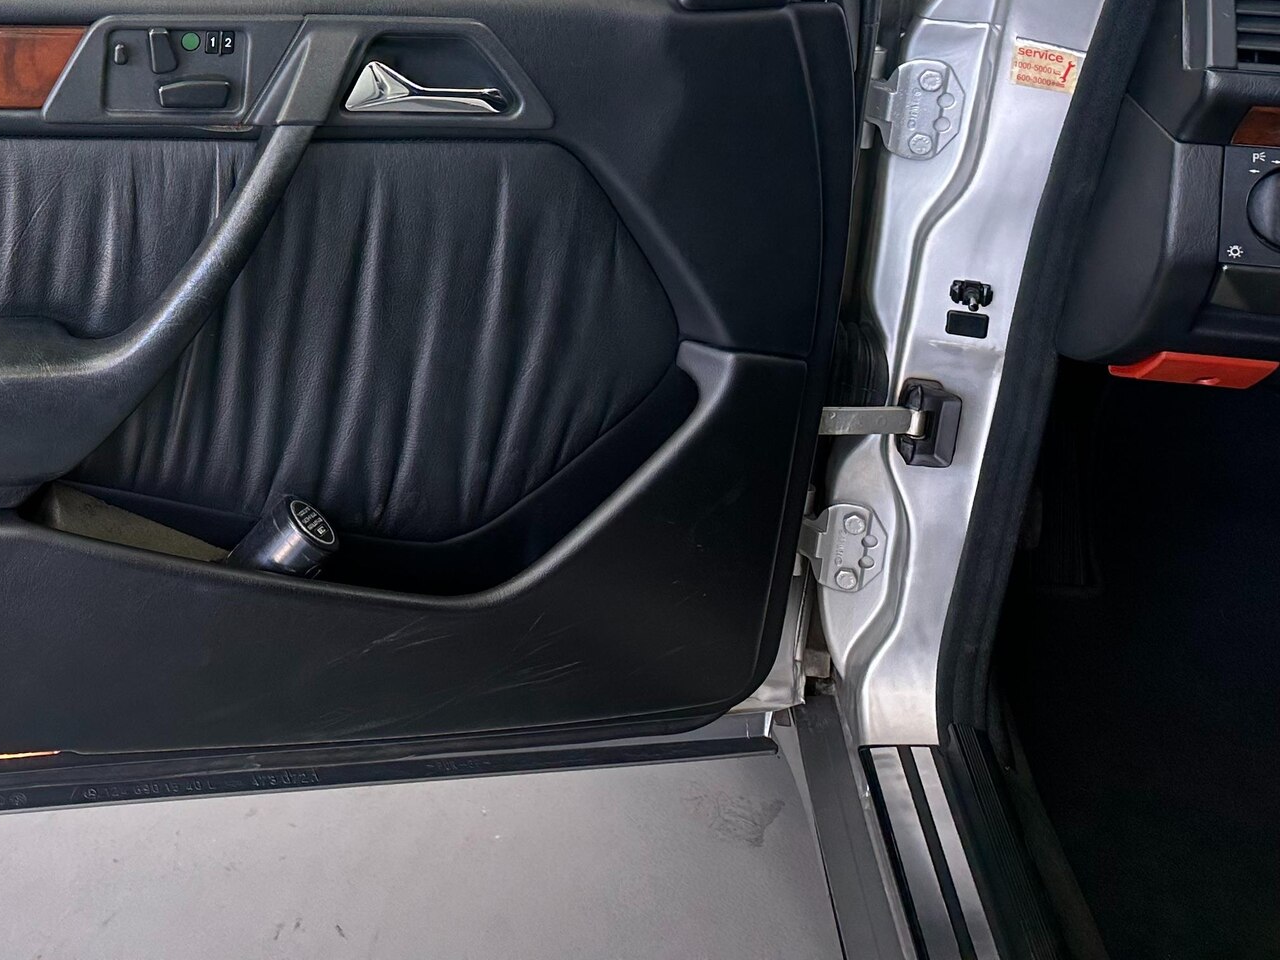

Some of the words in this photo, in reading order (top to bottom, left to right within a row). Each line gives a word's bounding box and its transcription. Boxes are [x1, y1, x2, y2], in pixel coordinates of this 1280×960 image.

[210, 37, 216, 48] 1
[224, 37, 232, 48] 2
[1017, 47, 1064, 63] service
[1014, 60, 1053, 75] 1000-5000
[1016, 73, 1053, 86] 600-3000
